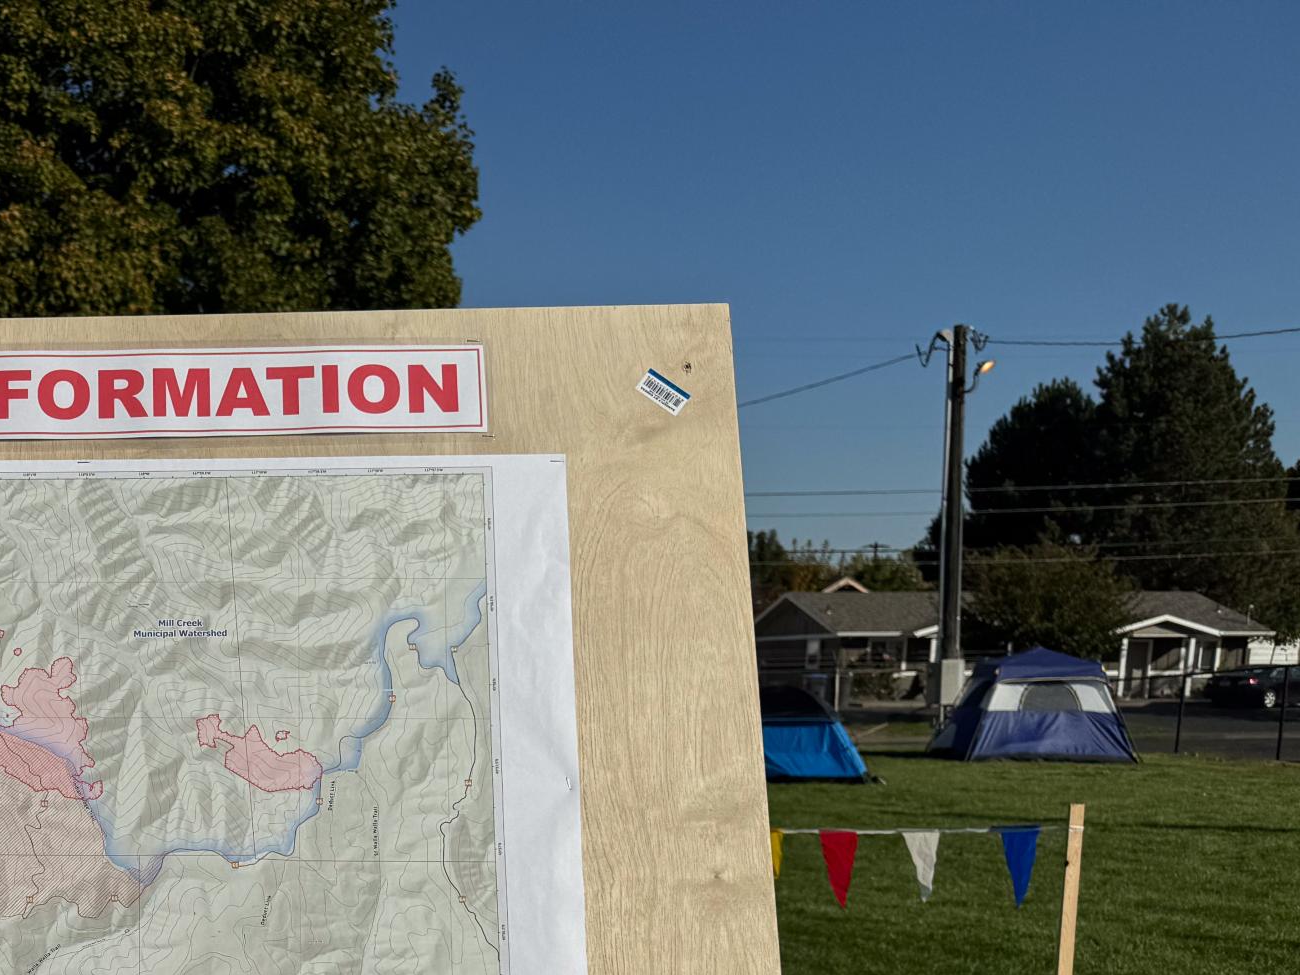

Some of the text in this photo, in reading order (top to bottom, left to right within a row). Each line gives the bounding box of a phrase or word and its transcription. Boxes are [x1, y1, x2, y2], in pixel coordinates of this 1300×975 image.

[158, 619, 203, 627] Mill Creek
[133, 629, 228, 638] Municipal Watershed
